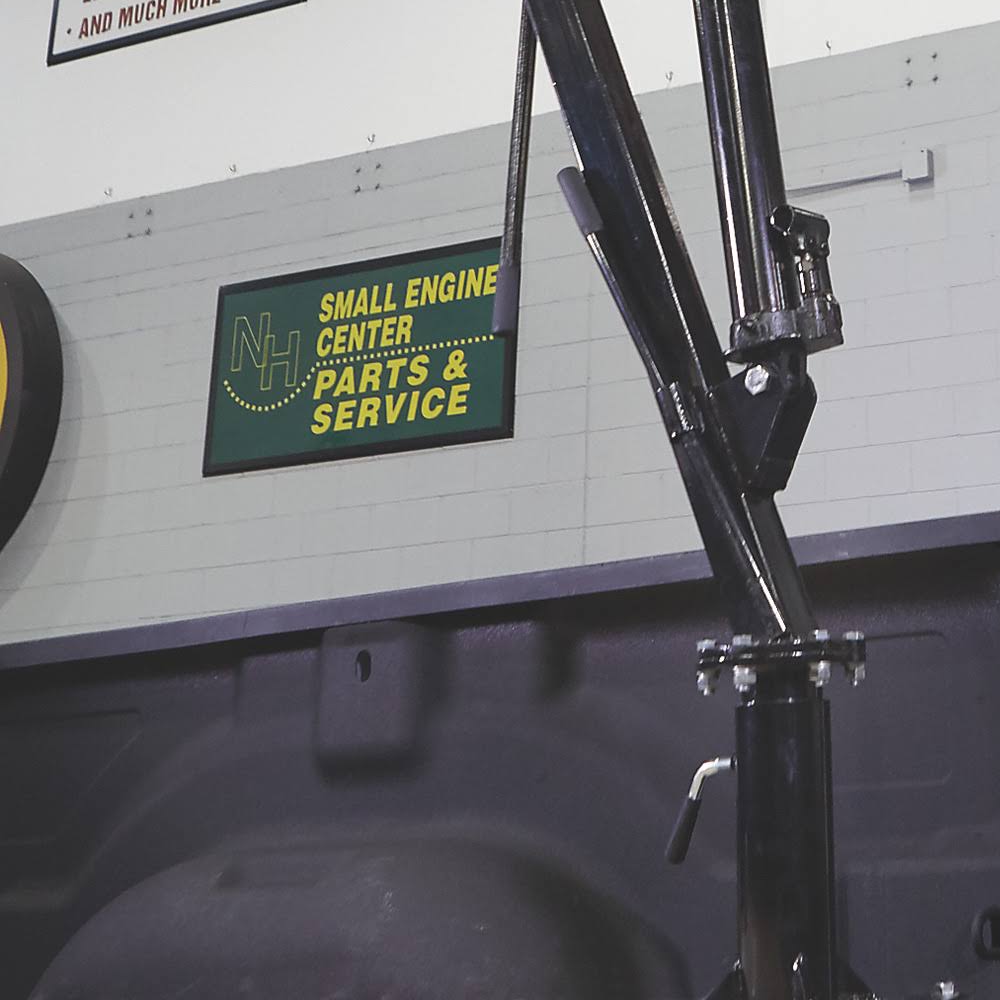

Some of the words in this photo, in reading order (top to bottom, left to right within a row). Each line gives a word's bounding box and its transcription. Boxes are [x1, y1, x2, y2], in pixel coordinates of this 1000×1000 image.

[78, 14, 112, 39] AND
[318, 283, 397, 323] SMALL
[404, 264, 500, 309] ENGINE
[316, 314, 414, 357] CENTER
[312, 354, 430, 400] PARTS
[442, 349, 469, 381] &
[310, 383, 471, 434] SERVICE
